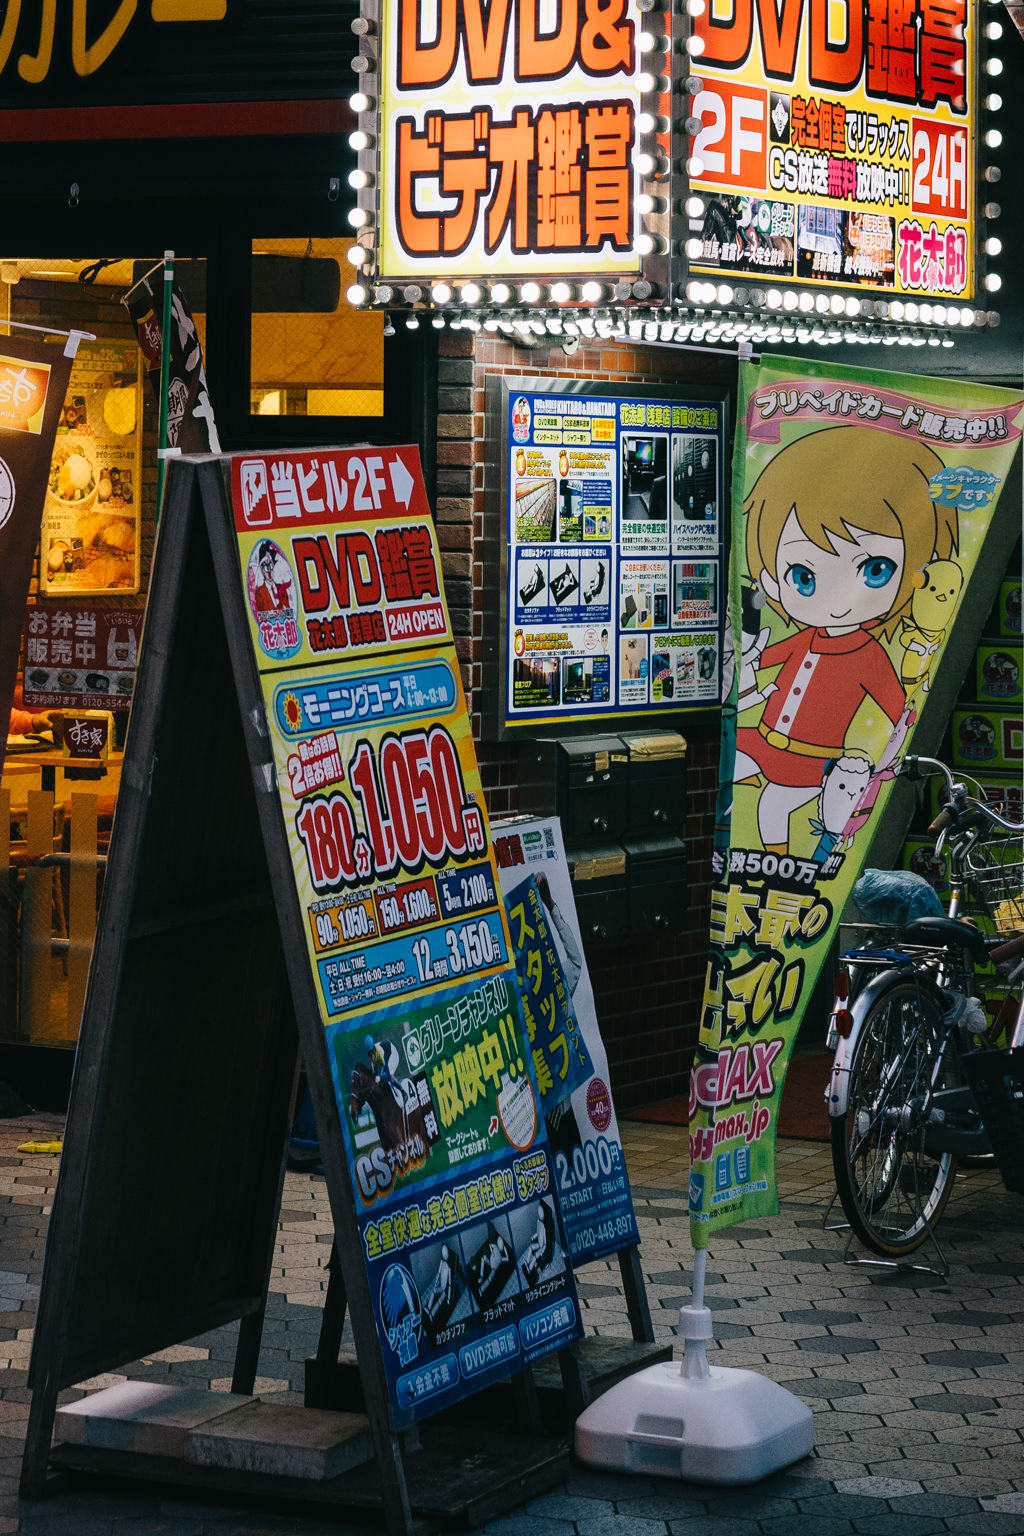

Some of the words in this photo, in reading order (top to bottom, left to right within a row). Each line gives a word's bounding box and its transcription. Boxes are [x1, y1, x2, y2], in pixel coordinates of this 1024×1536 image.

[692, 89, 765, 176] 2F
[790, 95, 911, 162] 完全個室でリラックス
[396, 101, 633, 259] ビデオ鑑賞
[769, 145, 911, 208] CS放送無料放映中!!
[912, 128, 968, 210] 24H
[898, 218, 968, 294] 花太郎
[619, 402, 646, 427] 花太郎
[646, 404, 672, 428] 浅草店
[754, 389, 1008, 442] プリペイドカード販売中!!
[271, 456, 387, 519] 当ビル2F
[929, 472, 1001, 485] イメージキャラクター
[929, 483, 986, 501] ラブです
[290, 524, 441, 614] DVD鑑賞
[28, 610, 97, 638] お弁当
[260, 617, 299, 652] 花太郎
[306, 615, 349, 652] 花太郎
[347, 610, 388, 647] 浅草店
[388, 612, 413, 636] 24H
[412, 608, 445, 632] OPEN
[27, 637, 96, 666] 販売中
[303, 678, 406, 724] モーニングコース
[403, 675, 417, 691] 平日
[68, 719, 103, 749] すき家
[289, 750, 344, 797] 2倍お得!!
[297, 794, 372, 889] 180分
[350, 728, 486, 874] 1,050円
[379, 896, 405, 930] 150分
[402, 887, 437, 923] 1,600円
[441, 882, 462, 912] 5時間
[460, 873, 495, 908] 2,100円
[315, 912, 339, 948] 90分
[338, 903, 376, 942] 1,050円
[325, 963, 339, 978] 平日
[339, 959, 351, 973] ALL
[350, 955, 367, 970] TIME
[412, 936, 450, 984] 12時間
[444, 918, 503, 975] 3,150円
[509, 900, 570, 1081] スタッフ
[527, 887, 586, 1067] 金太郎・花太郎フロント
[419, 974, 510, 1065] グリーンチャンネル
[430, 1013, 525, 1131] 放映中!!
[416, 1076, 439, 1140] 無料
[356, 1134, 425, 1199] CSチャンネル
[517, 1168, 549, 1201] 3タイプ
[363, 1169, 515, 1262] 全室快適な完全個室仕様!!
[483, 1299, 517, 1323] フラットマット
[524, 1276, 567, 1303] リクライニングシート
[388, 1312, 422, 1352] シャワー
[435, 1322, 466, 1345] カウチソファ
[524, 1304, 570, 1341] パソコン完備
[463, 1333, 517, 1372] DVD交換可能
